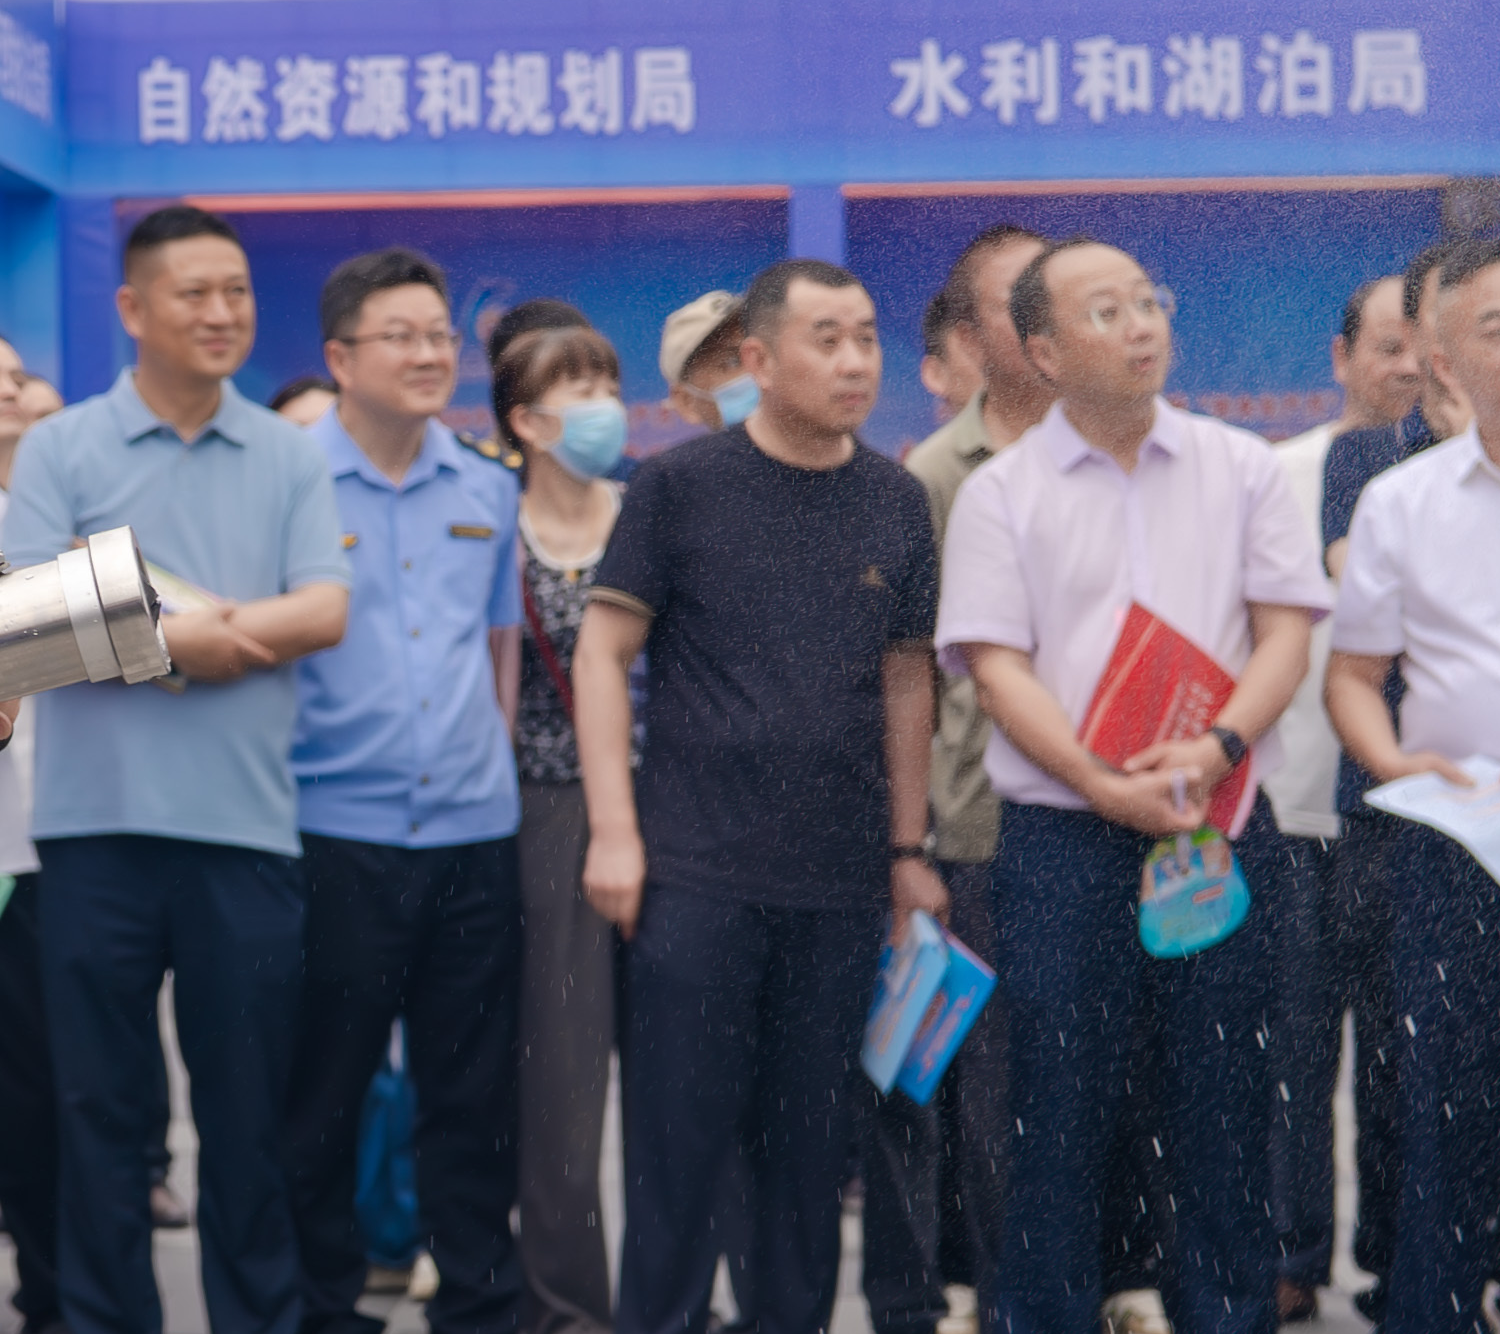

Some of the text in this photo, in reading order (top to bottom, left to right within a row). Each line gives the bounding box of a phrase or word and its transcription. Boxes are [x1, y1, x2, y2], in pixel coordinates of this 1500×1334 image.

[138, 46, 698, 144] 自然资源和规划局
[888, 28, 1427, 128] 水利和湖泊局
